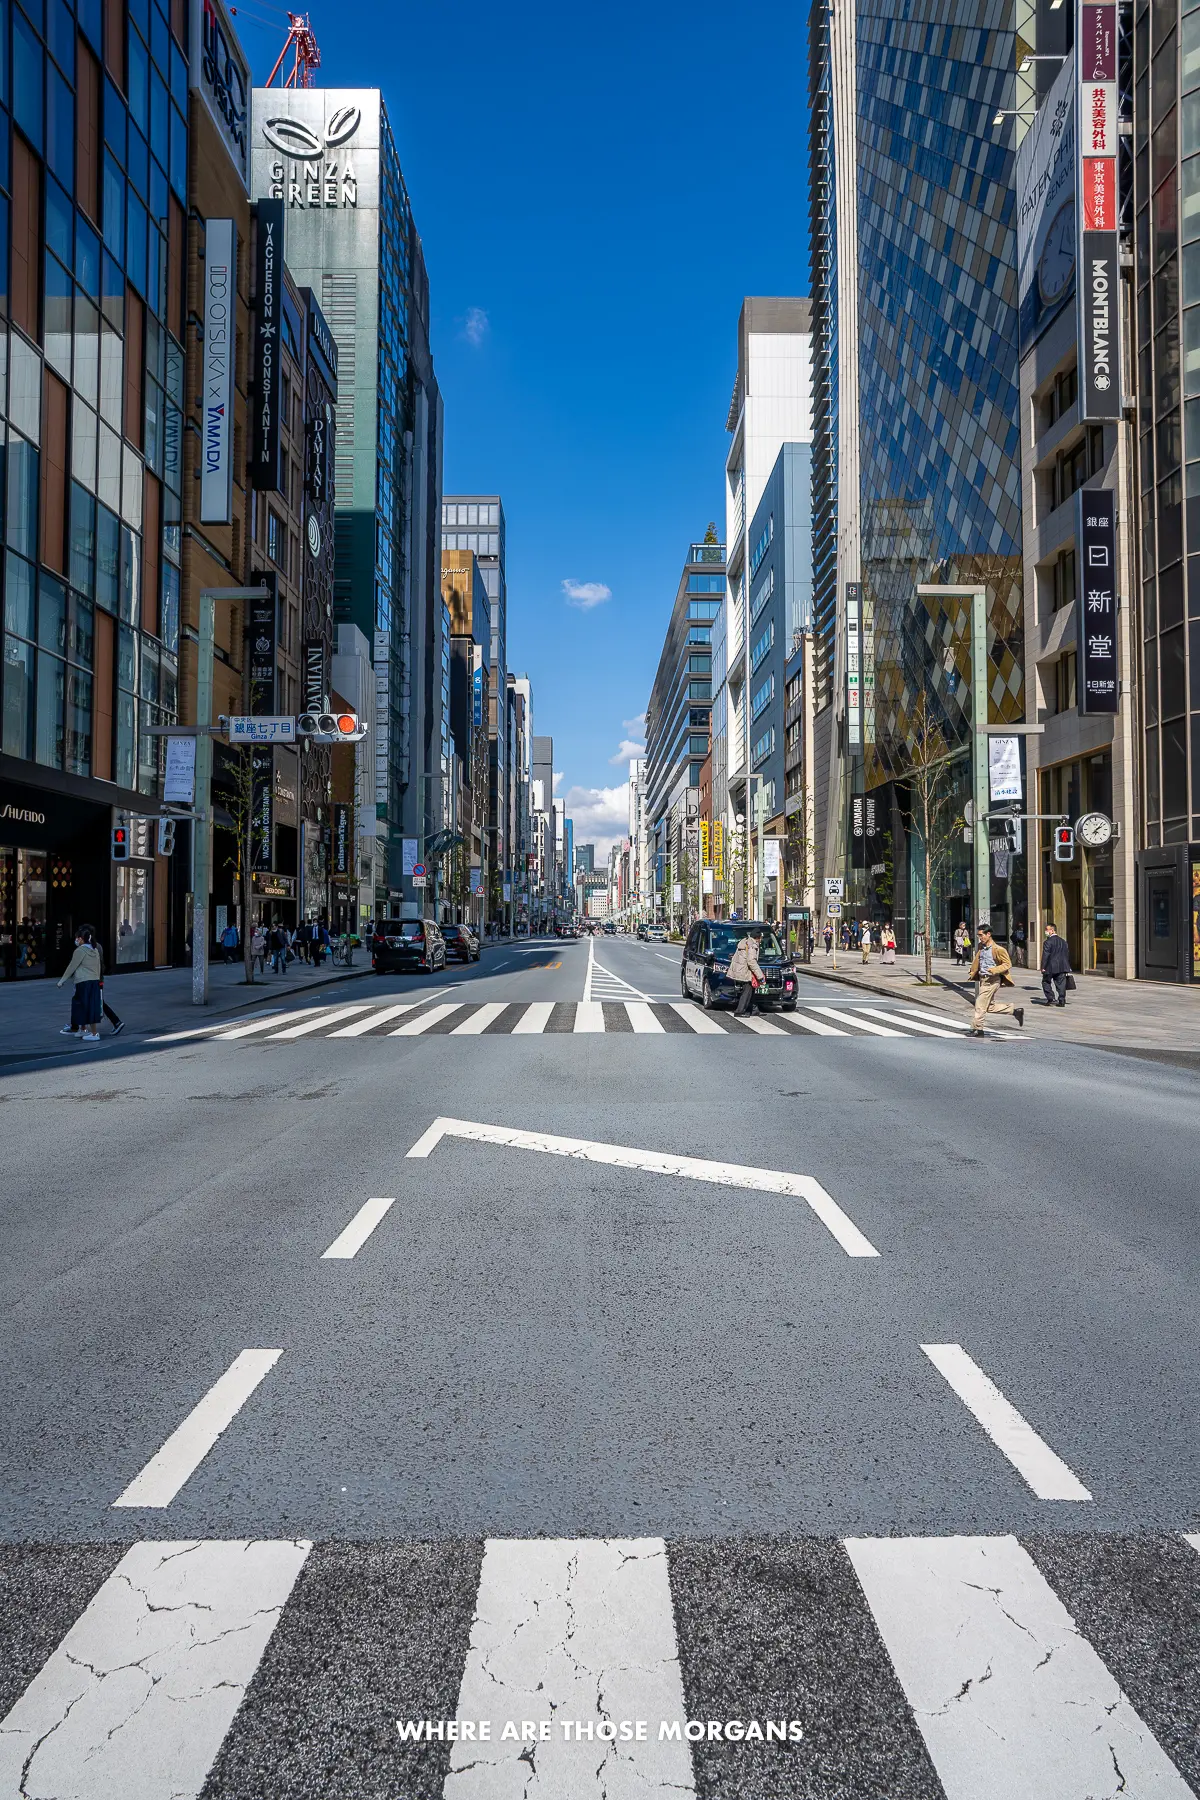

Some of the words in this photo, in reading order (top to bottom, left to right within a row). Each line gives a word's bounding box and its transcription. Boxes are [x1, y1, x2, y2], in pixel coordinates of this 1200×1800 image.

[1092, 88, 1106, 150] 共立美容外科
[269, 160, 357, 181] GINZA
[269, 183, 357, 204] GREEN
[1021, 161, 1052, 225] PATEK
[1093, 162, 1105, 228] 東京美容外科
[210, 265, 228, 299] IDC
[264, 222, 274, 318] VACHERON
[208, 303, 227, 382] OTSUKA
[1092, 259, 1110, 374] MONTBLANC
[261, 343, 272, 463] CONSTANTIN
[206, 402, 226, 474] YAMADA
[312, 419, 323, 498] DAMIANI
[1086, 516, 1109, 527] 銀座
[1088, 545, 1112, 658] 日新堂
[307, 646, 323, 714] DAMIANI
[234, 722, 291, 734] 銀座七丁目
[0, 804, 46, 824] SHISEIDO
[853, 798, 863, 828] YAMAHA
